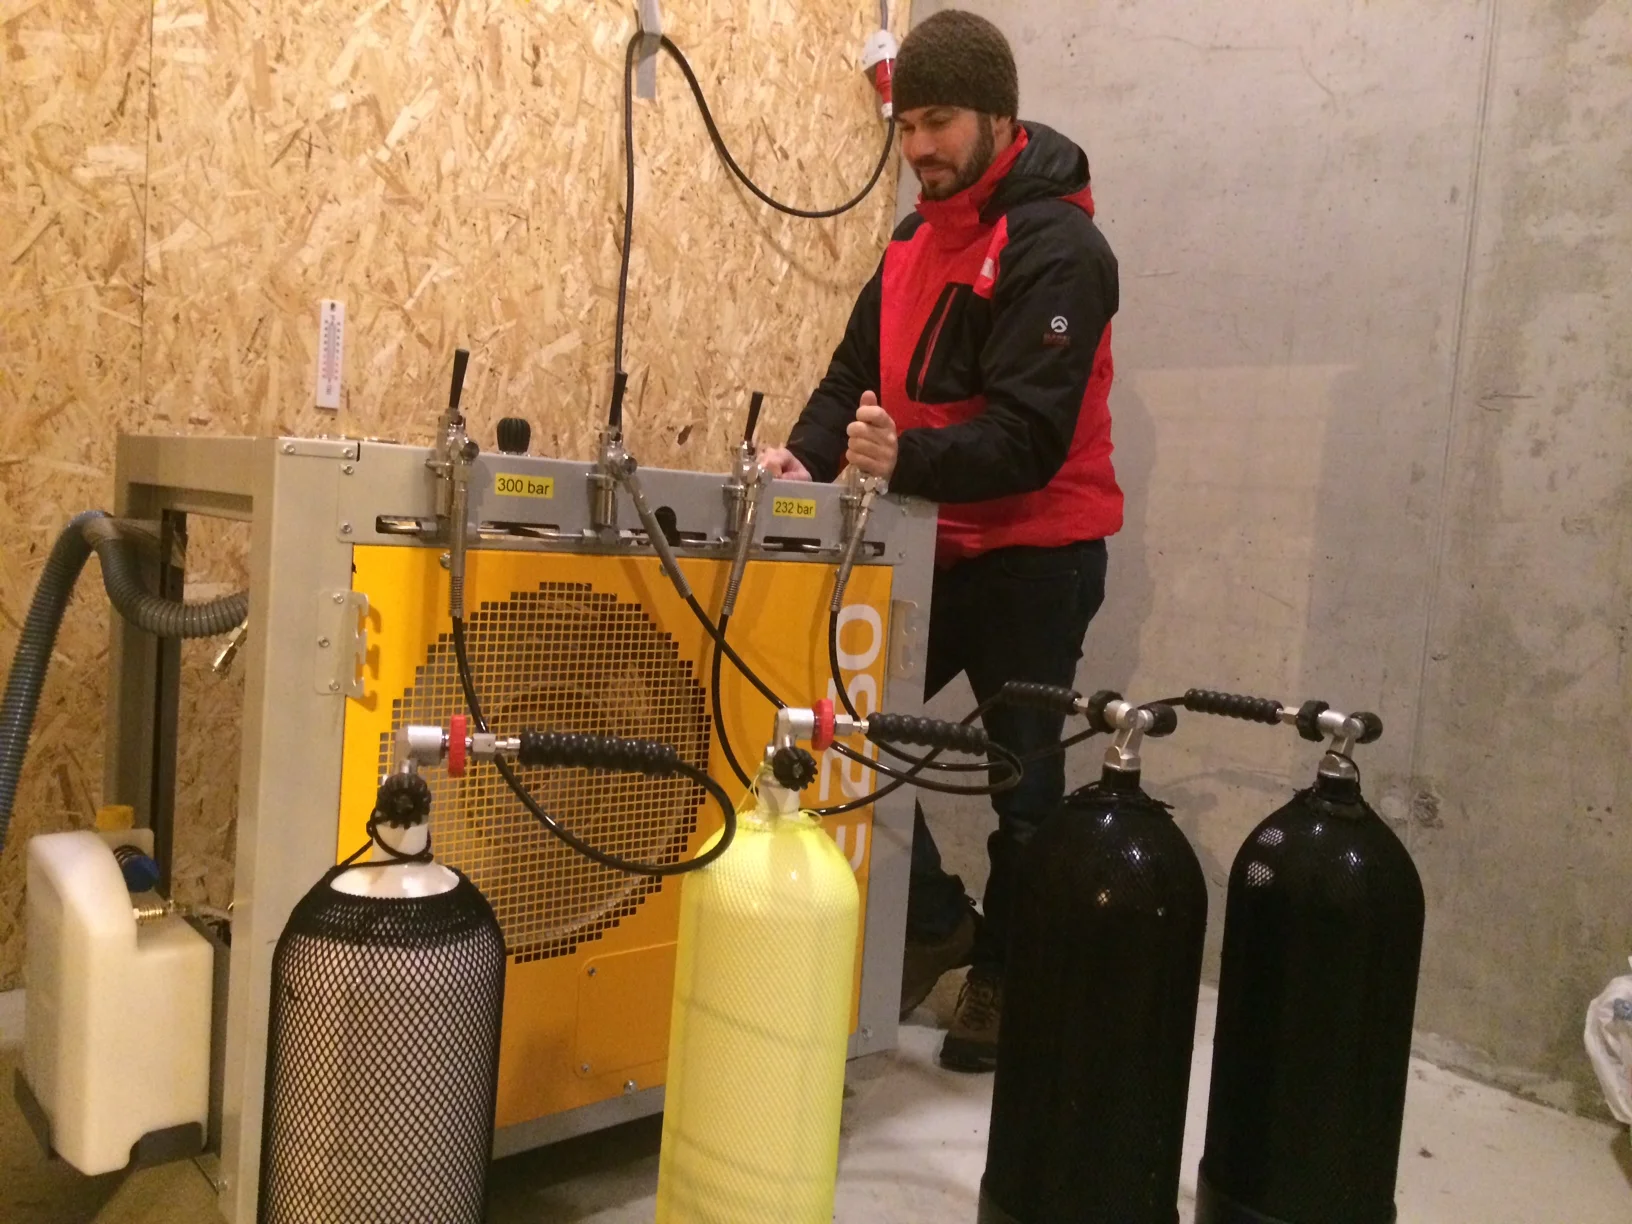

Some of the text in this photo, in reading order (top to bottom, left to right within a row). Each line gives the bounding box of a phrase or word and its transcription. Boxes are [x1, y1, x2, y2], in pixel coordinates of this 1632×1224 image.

[497, 477, 550, 495] 300 bar
[774, 501, 814, 515] 232 bar
